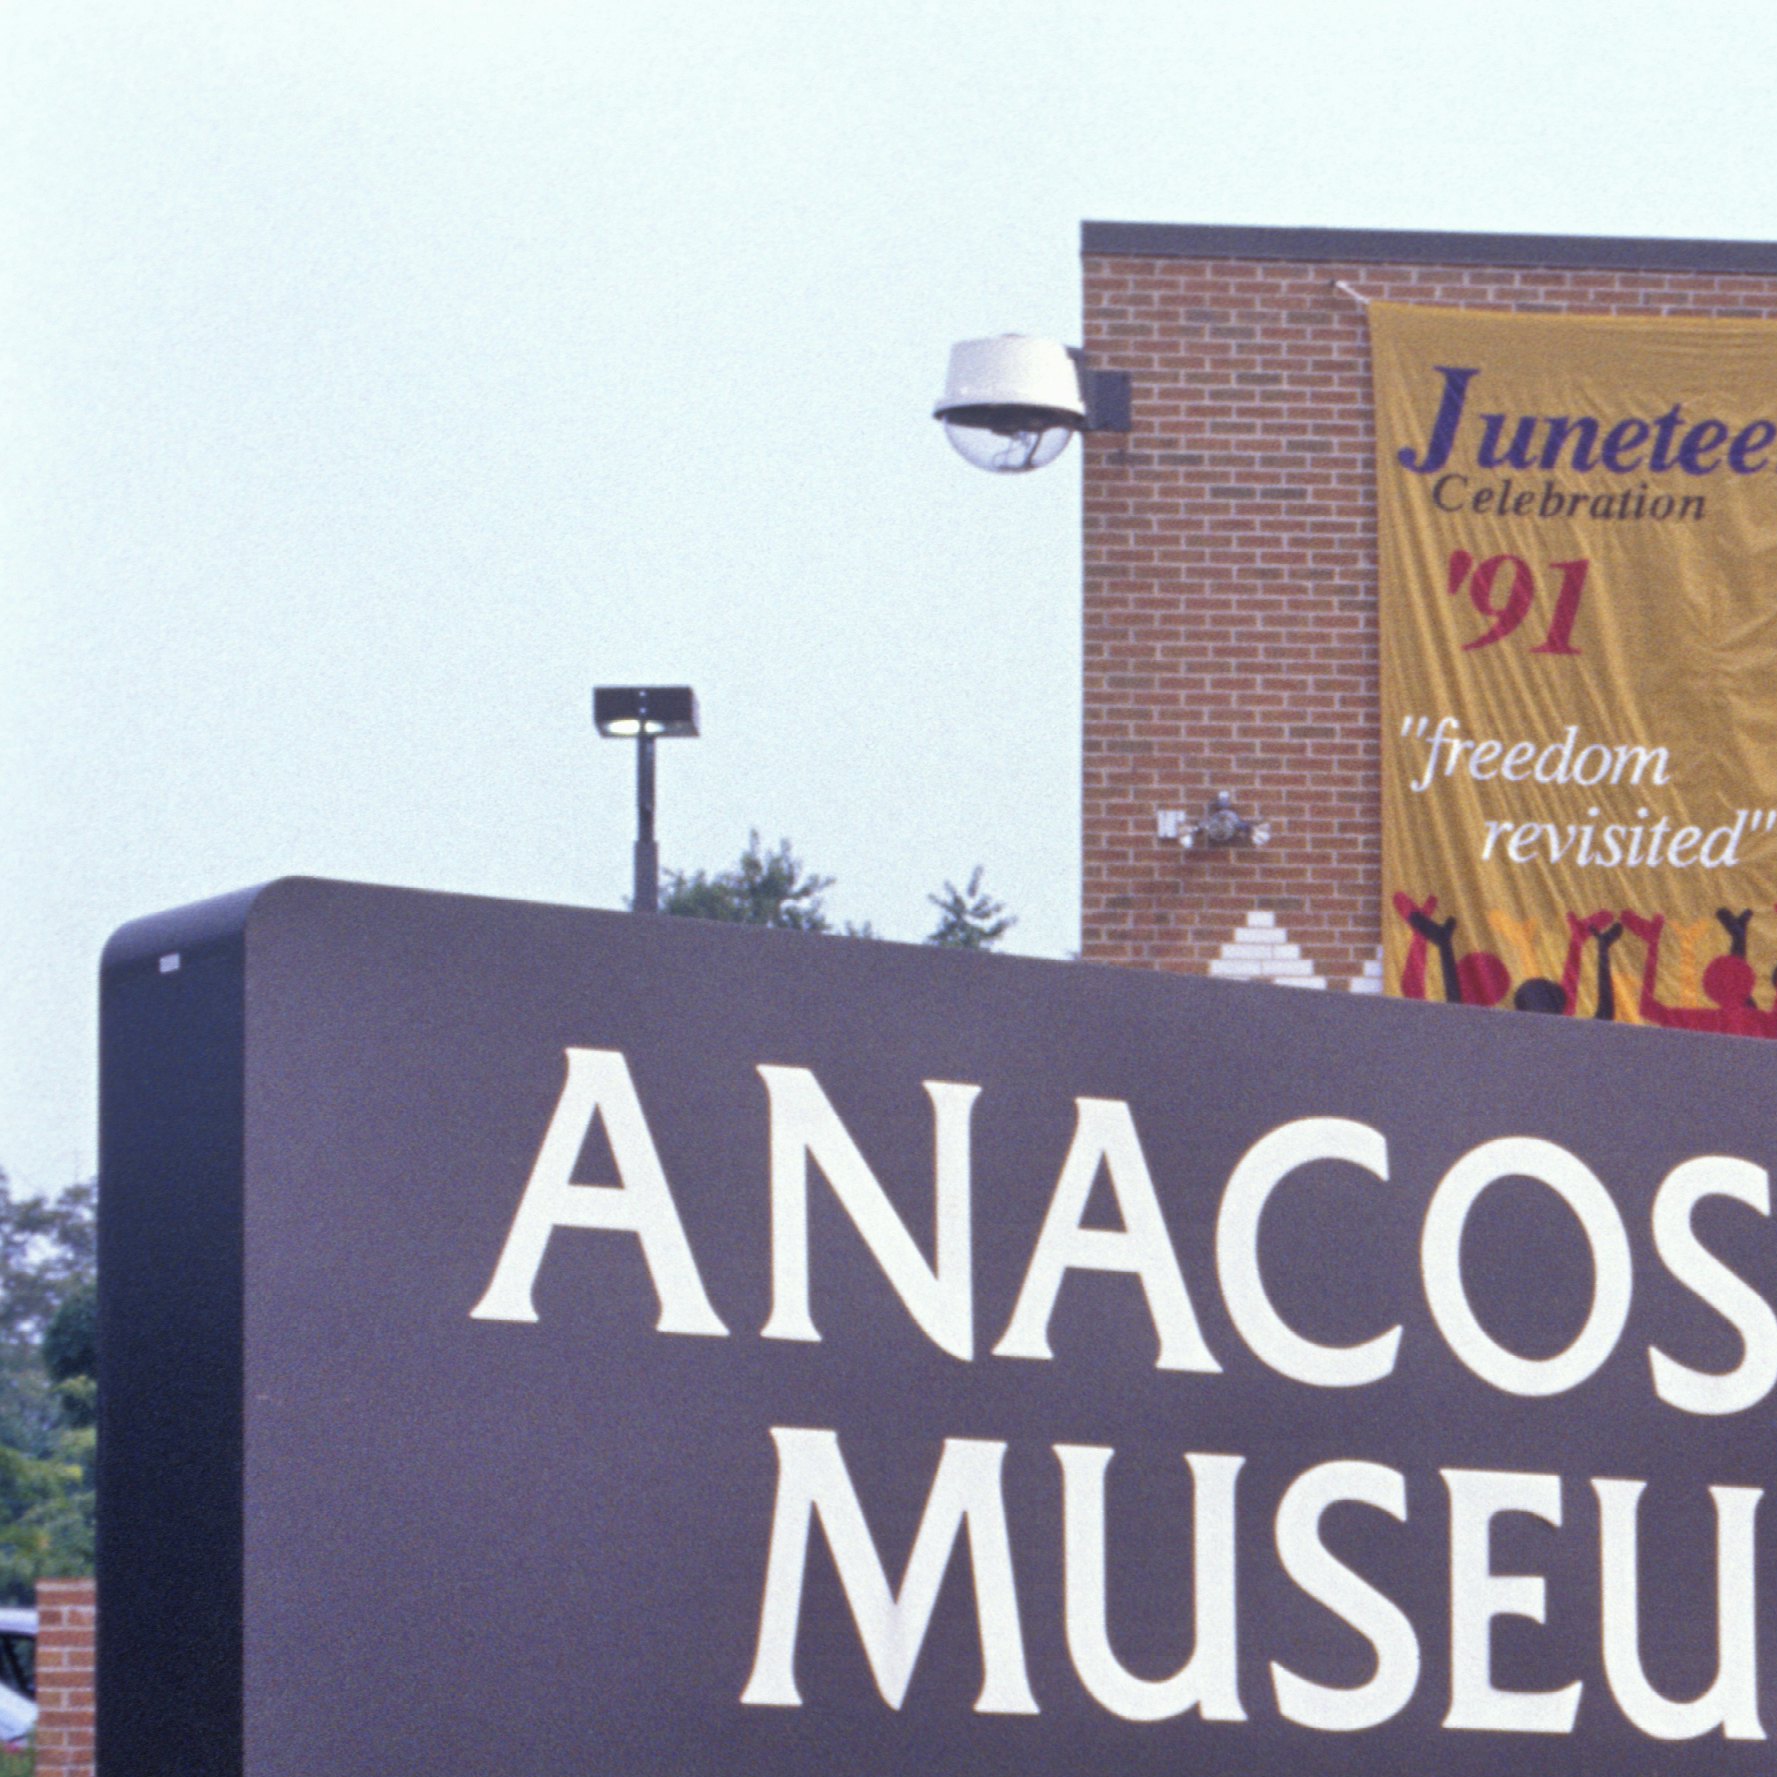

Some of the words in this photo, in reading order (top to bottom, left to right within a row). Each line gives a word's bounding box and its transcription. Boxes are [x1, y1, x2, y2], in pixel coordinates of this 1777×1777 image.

[1431, 473, 1707, 521] Celebration
[1449, 550, 1587, 655] '91
[1400, 714, 1671, 793] "freedom
